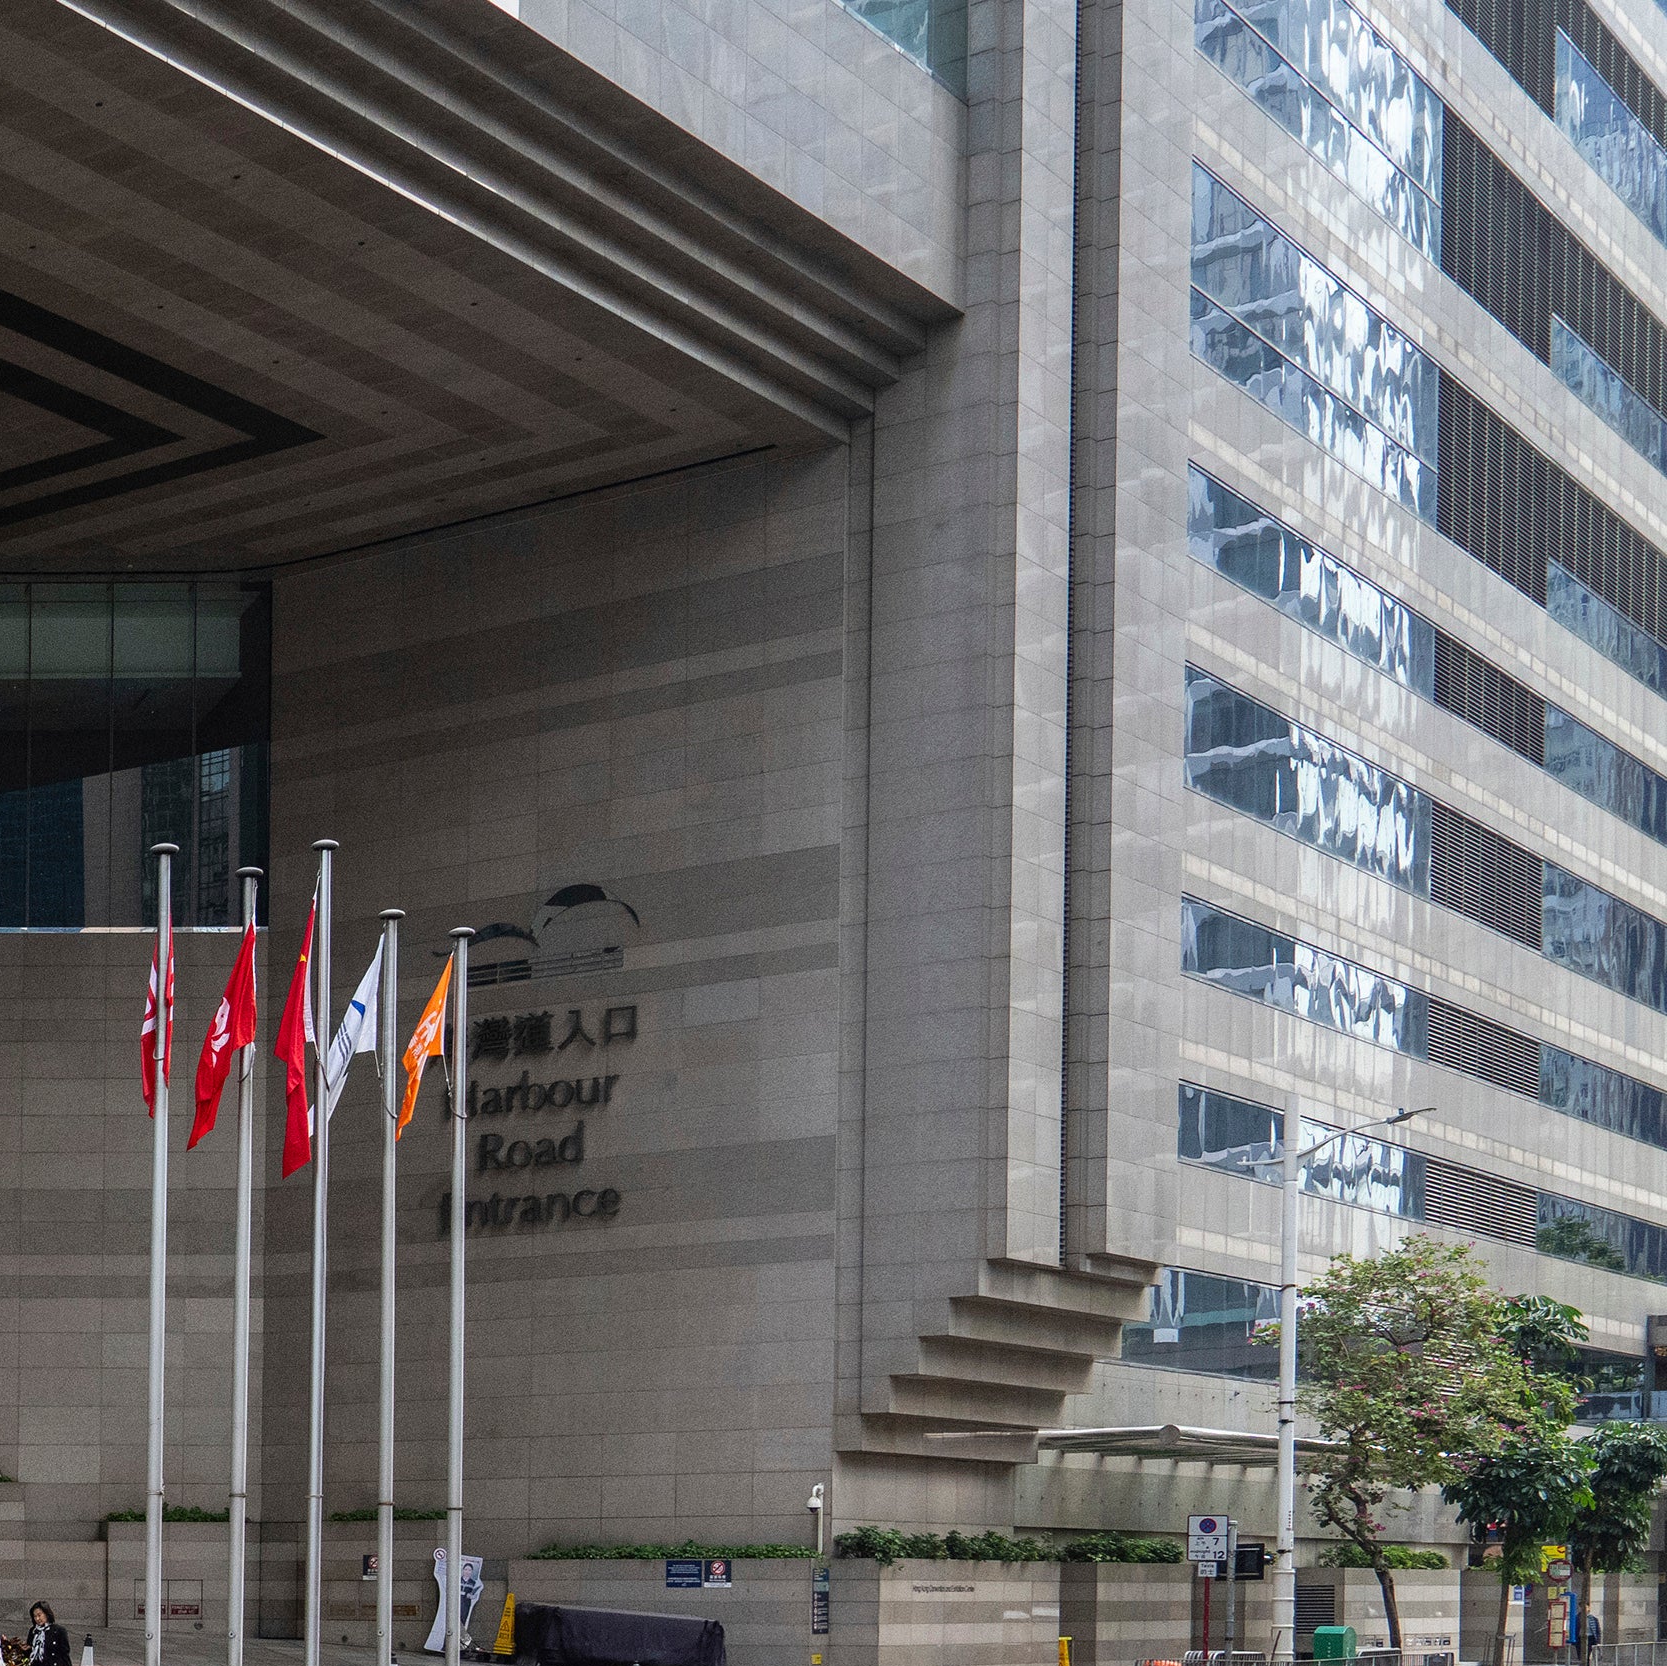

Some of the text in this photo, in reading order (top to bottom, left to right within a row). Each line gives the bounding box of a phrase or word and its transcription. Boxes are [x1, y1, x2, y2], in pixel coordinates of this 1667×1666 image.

[444, 1005, 637, 1060] 灣道入口
[478, 1120, 586, 1171] Road
[1212, 1537, 1220, 1546] 7
[1212, 1551, 1225, 1559] 12
